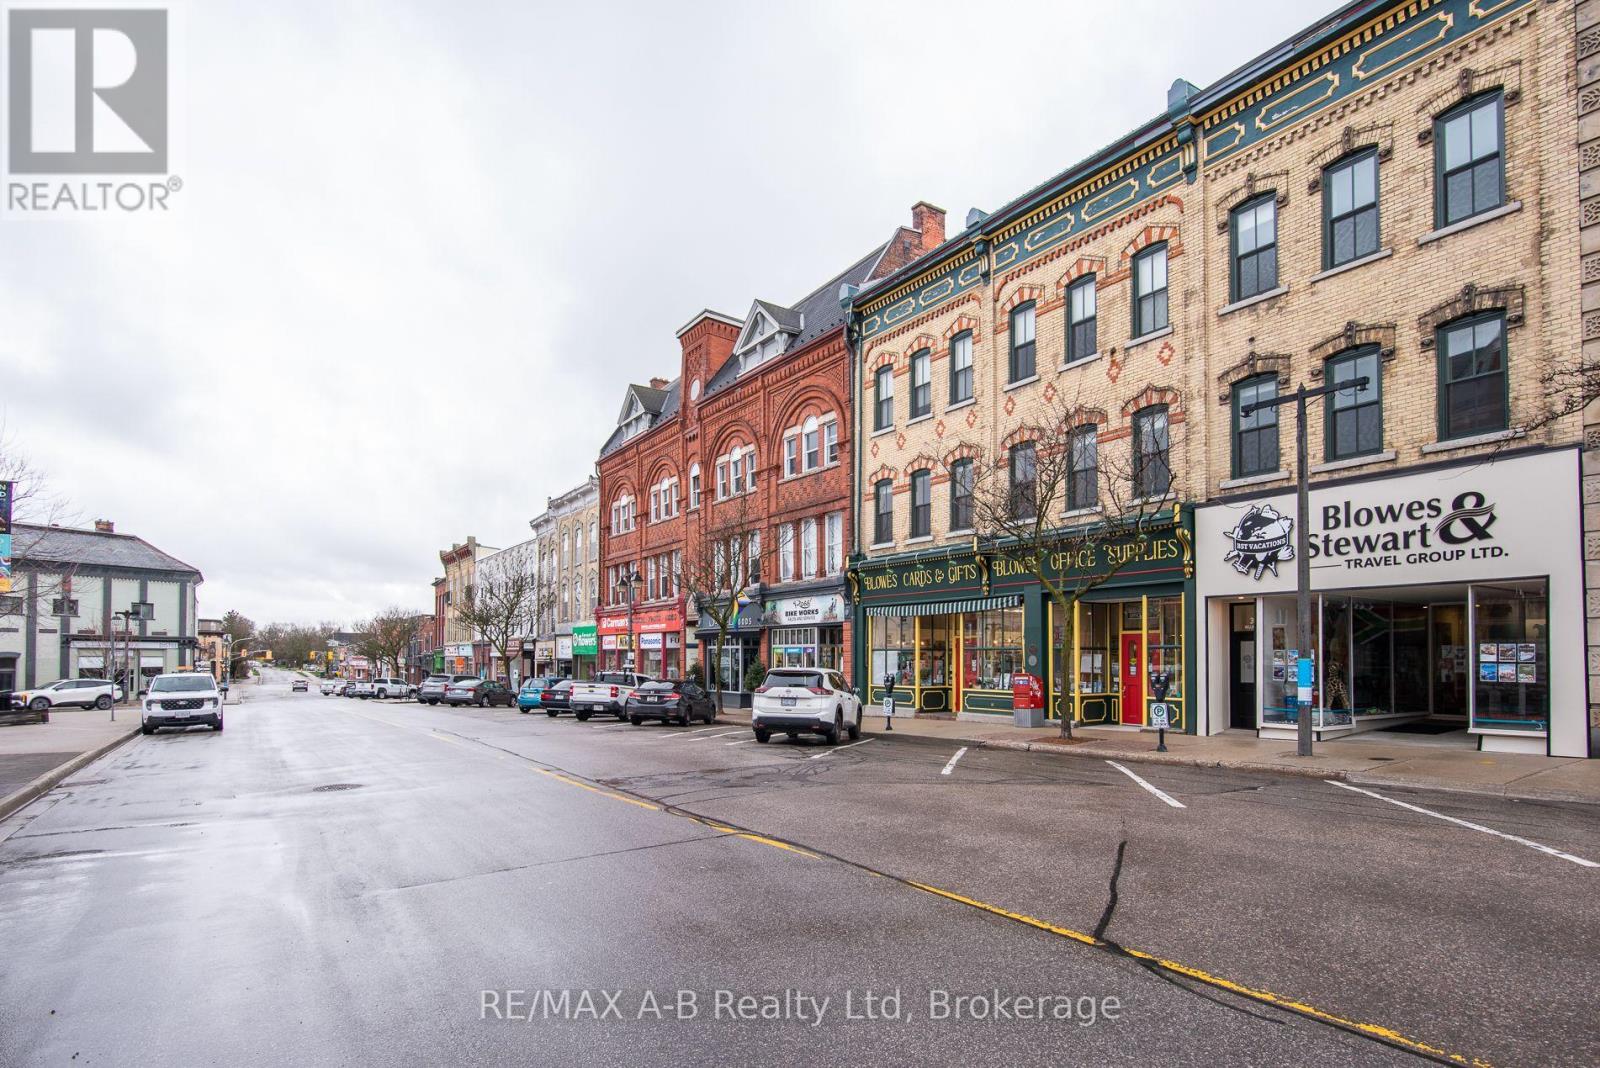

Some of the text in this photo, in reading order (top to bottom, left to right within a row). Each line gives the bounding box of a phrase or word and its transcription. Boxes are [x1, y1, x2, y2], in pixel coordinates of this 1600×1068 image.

[1322, 491, 1497, 545] Blowes &
[1248, 538, 1286, 550] VACATIONS
[1308, 522, 1431, 559] Stewart
[1344, 546, 1509, 569] TRAVEL GROUP LTD.
[863, 564, 977, 591] BLOWES CARDS & GIFTS
[785, 608, 819, 617] BIKE WORKS
[640, 636, 661, 646] Panasonic
